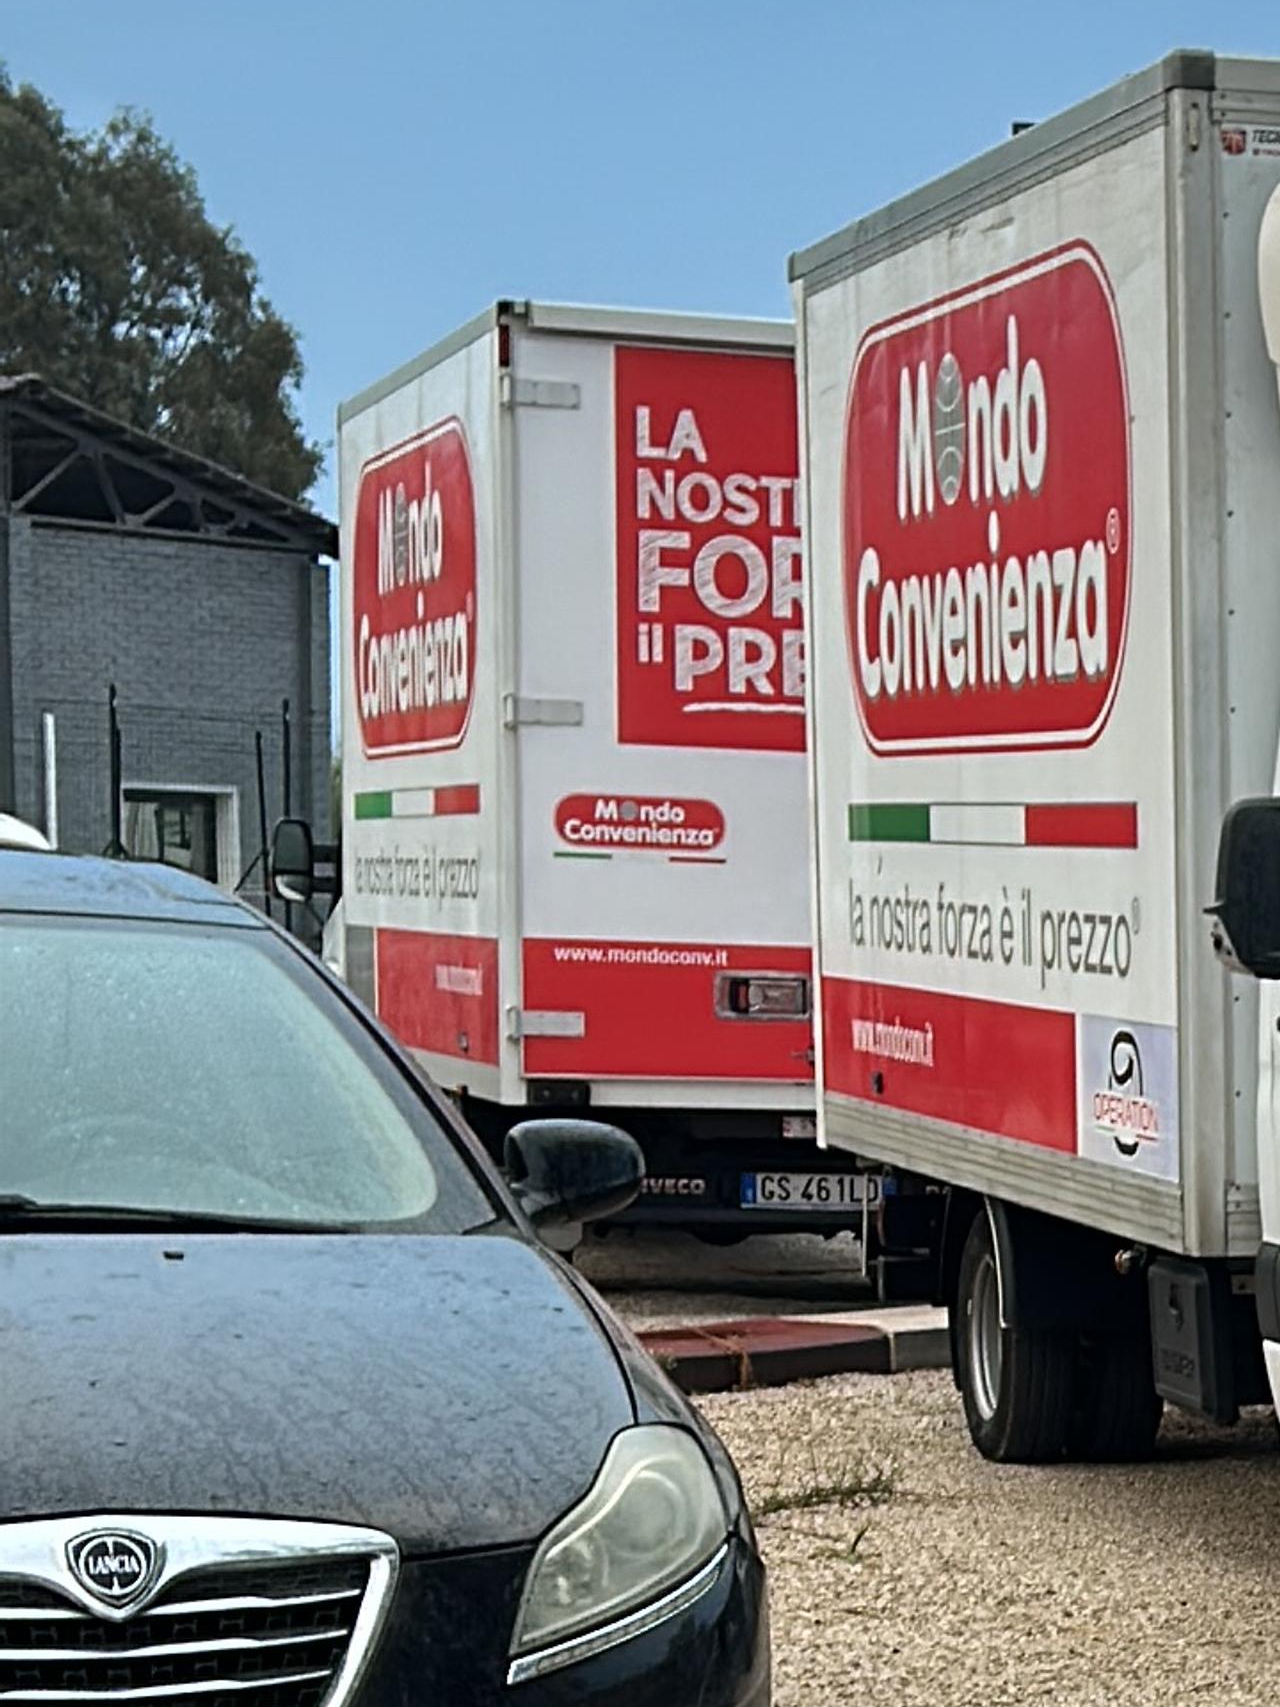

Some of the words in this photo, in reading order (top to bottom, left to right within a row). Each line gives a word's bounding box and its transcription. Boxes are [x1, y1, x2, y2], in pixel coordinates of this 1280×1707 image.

[635, 405, 708, 463] LA
[849, 877, 866, 947] la
[869, 883, 932, 955] nostra
[937, 882, 994, 964] forza
[999, 885, 1014, 965] è
[1021, 888, 1032, 967] il
[553, 946, 729, 966] www.mondoconv.it
[88, 1554, 140, 1575] LANCIA
